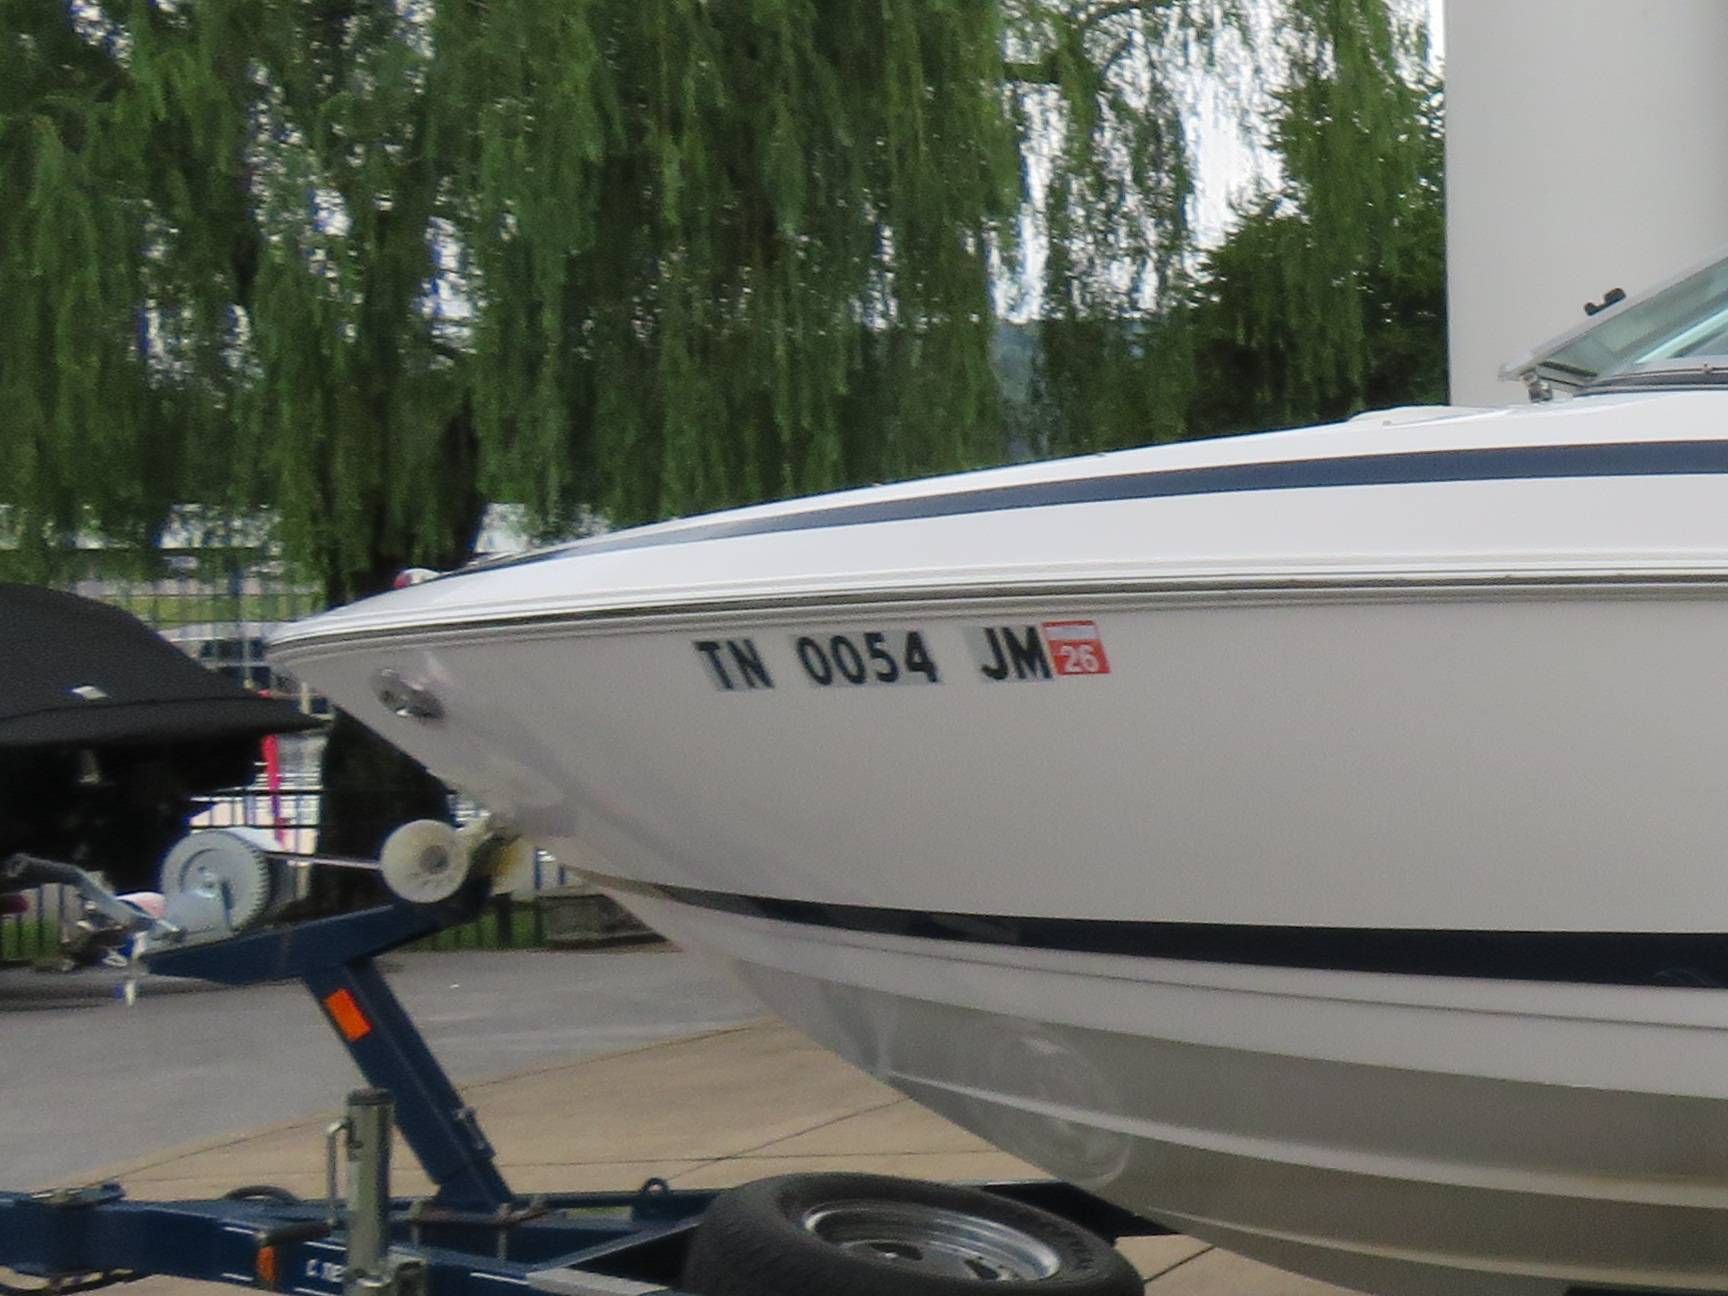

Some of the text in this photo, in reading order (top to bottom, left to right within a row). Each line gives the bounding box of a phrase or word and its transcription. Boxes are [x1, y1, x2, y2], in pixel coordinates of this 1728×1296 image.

[694, 625, 1054, 691] TN 0054 JM
[1059, 644, 1100, 673] 26
